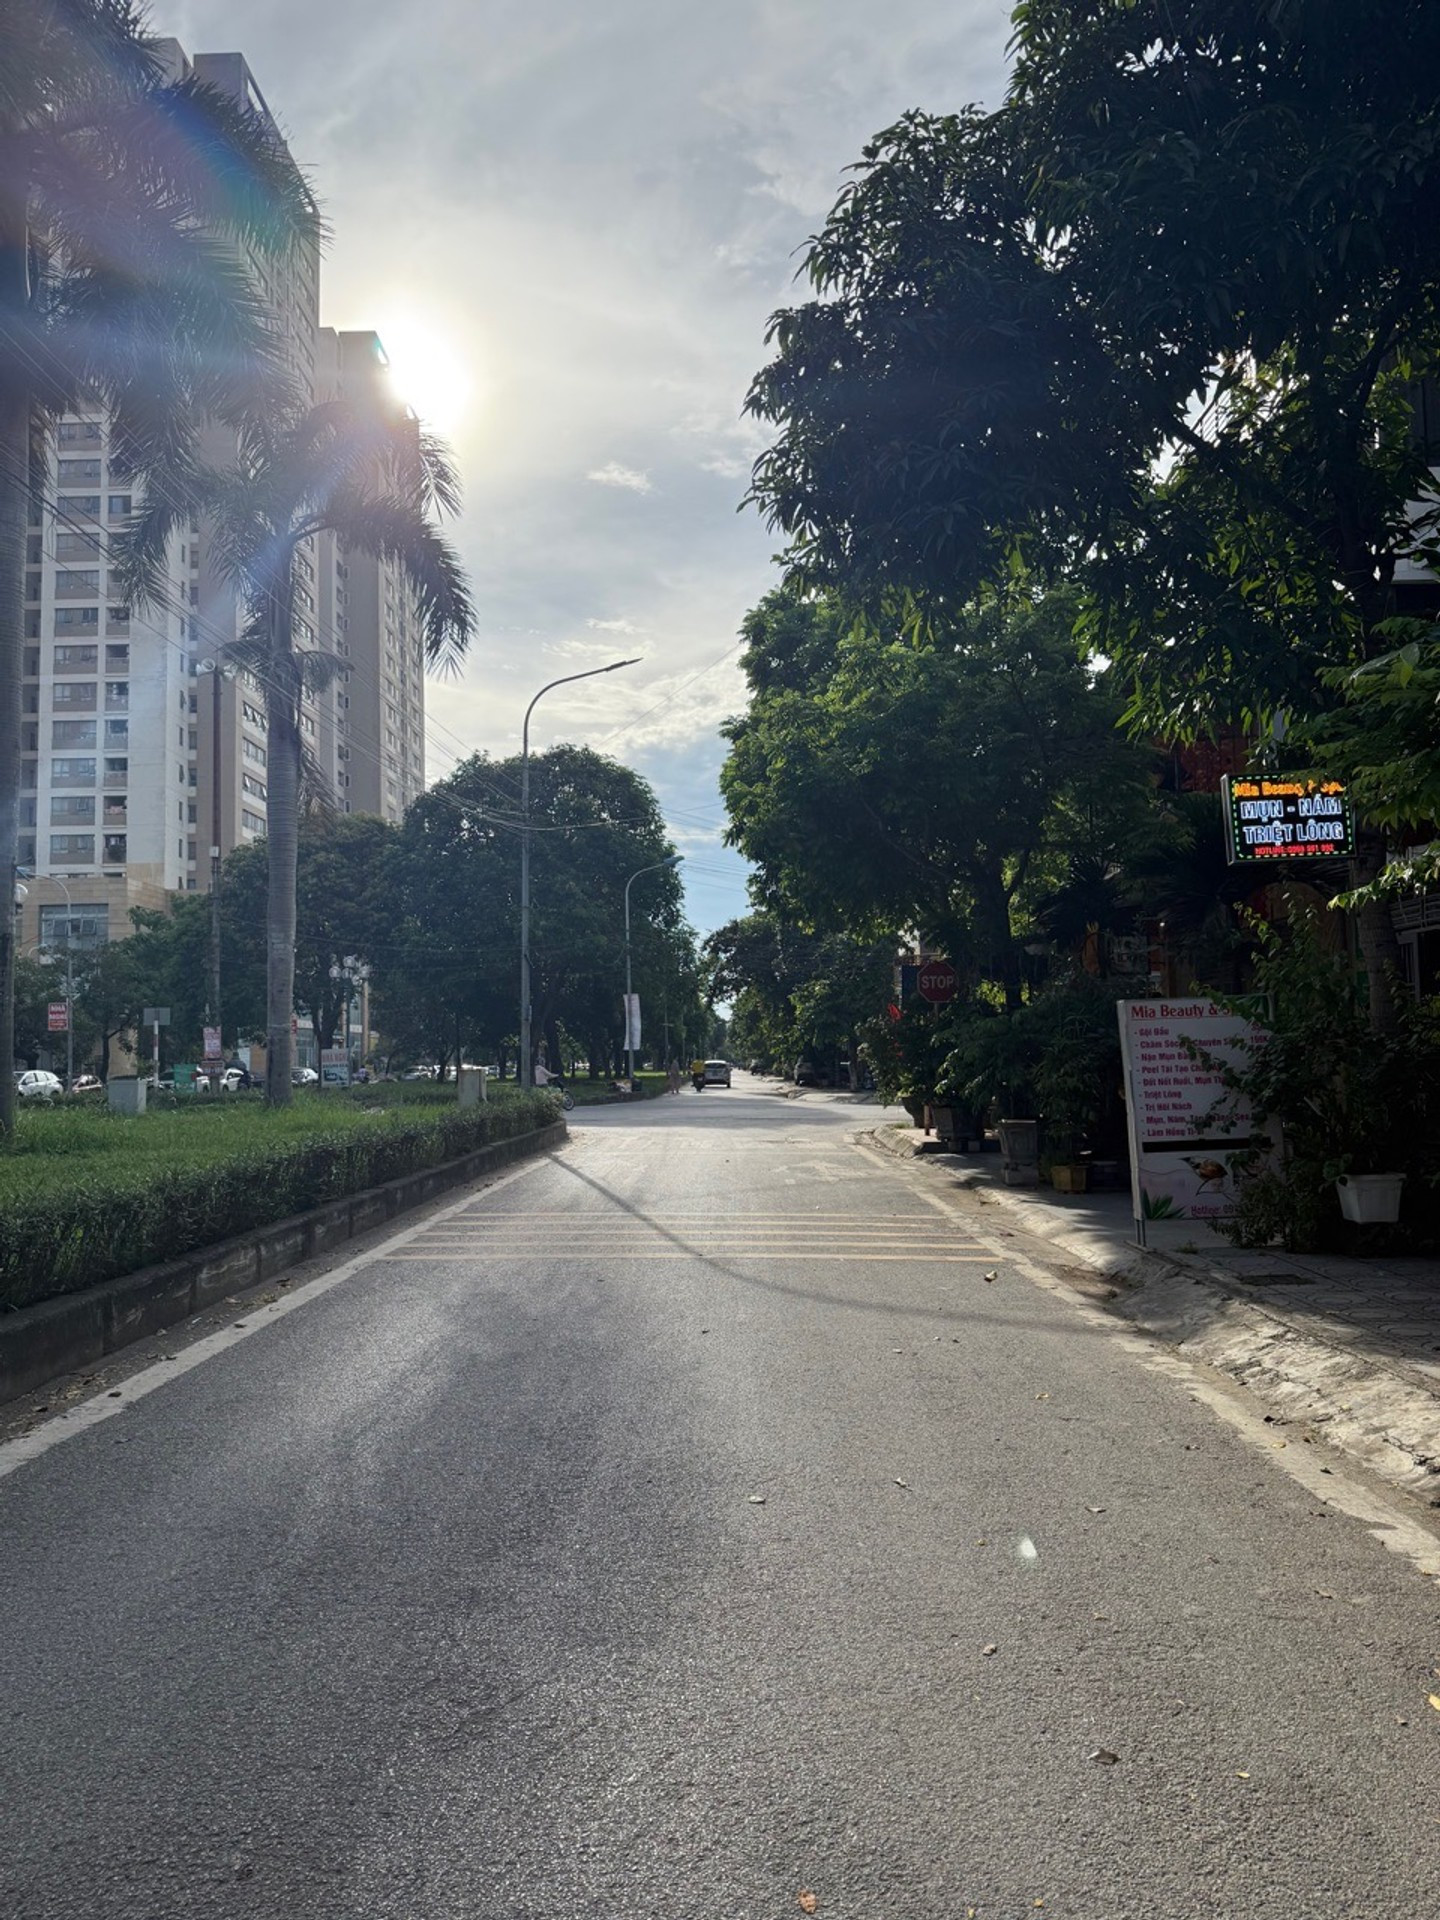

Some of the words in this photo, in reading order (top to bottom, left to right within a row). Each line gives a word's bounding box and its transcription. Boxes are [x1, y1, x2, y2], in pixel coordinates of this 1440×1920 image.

[1240, 800, 1284, 822] MỤN
[1243, 821, 1293, 845] TRIỆT
[1296, 819, 1344, 841] LÔNG
[921, 975, 955, 989] STOP
[1131, 1006, 1156, 1018] Mia
[1160, 1003, 1205, 1018] Beauty
